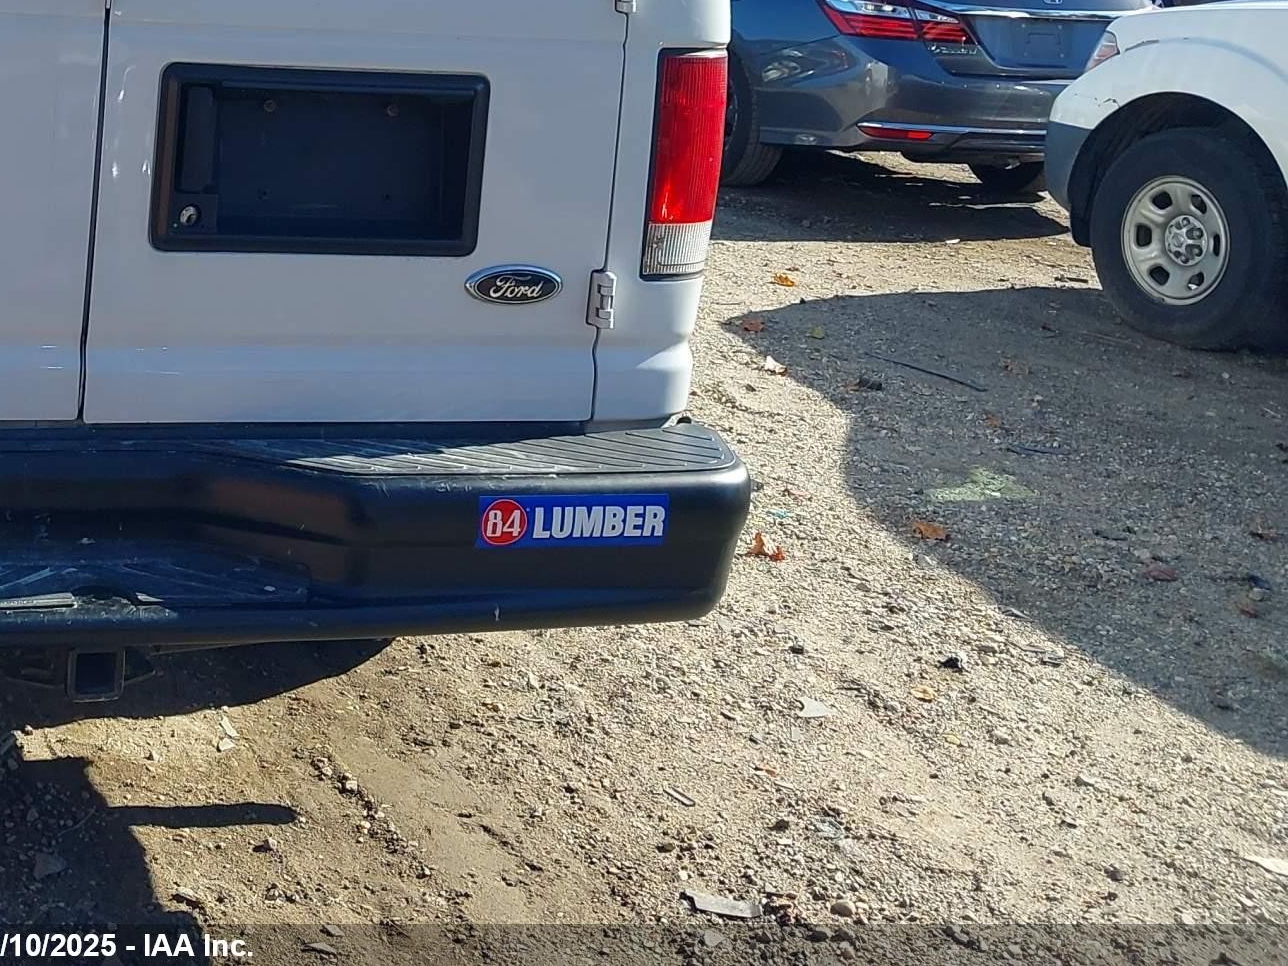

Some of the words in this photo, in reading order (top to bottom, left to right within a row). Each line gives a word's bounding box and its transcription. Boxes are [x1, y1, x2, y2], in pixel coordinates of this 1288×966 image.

[489, 275, 545, 298] Ford
[486, 509, 522, 537] 84
[532, 505, 666, 539] LUMBER
